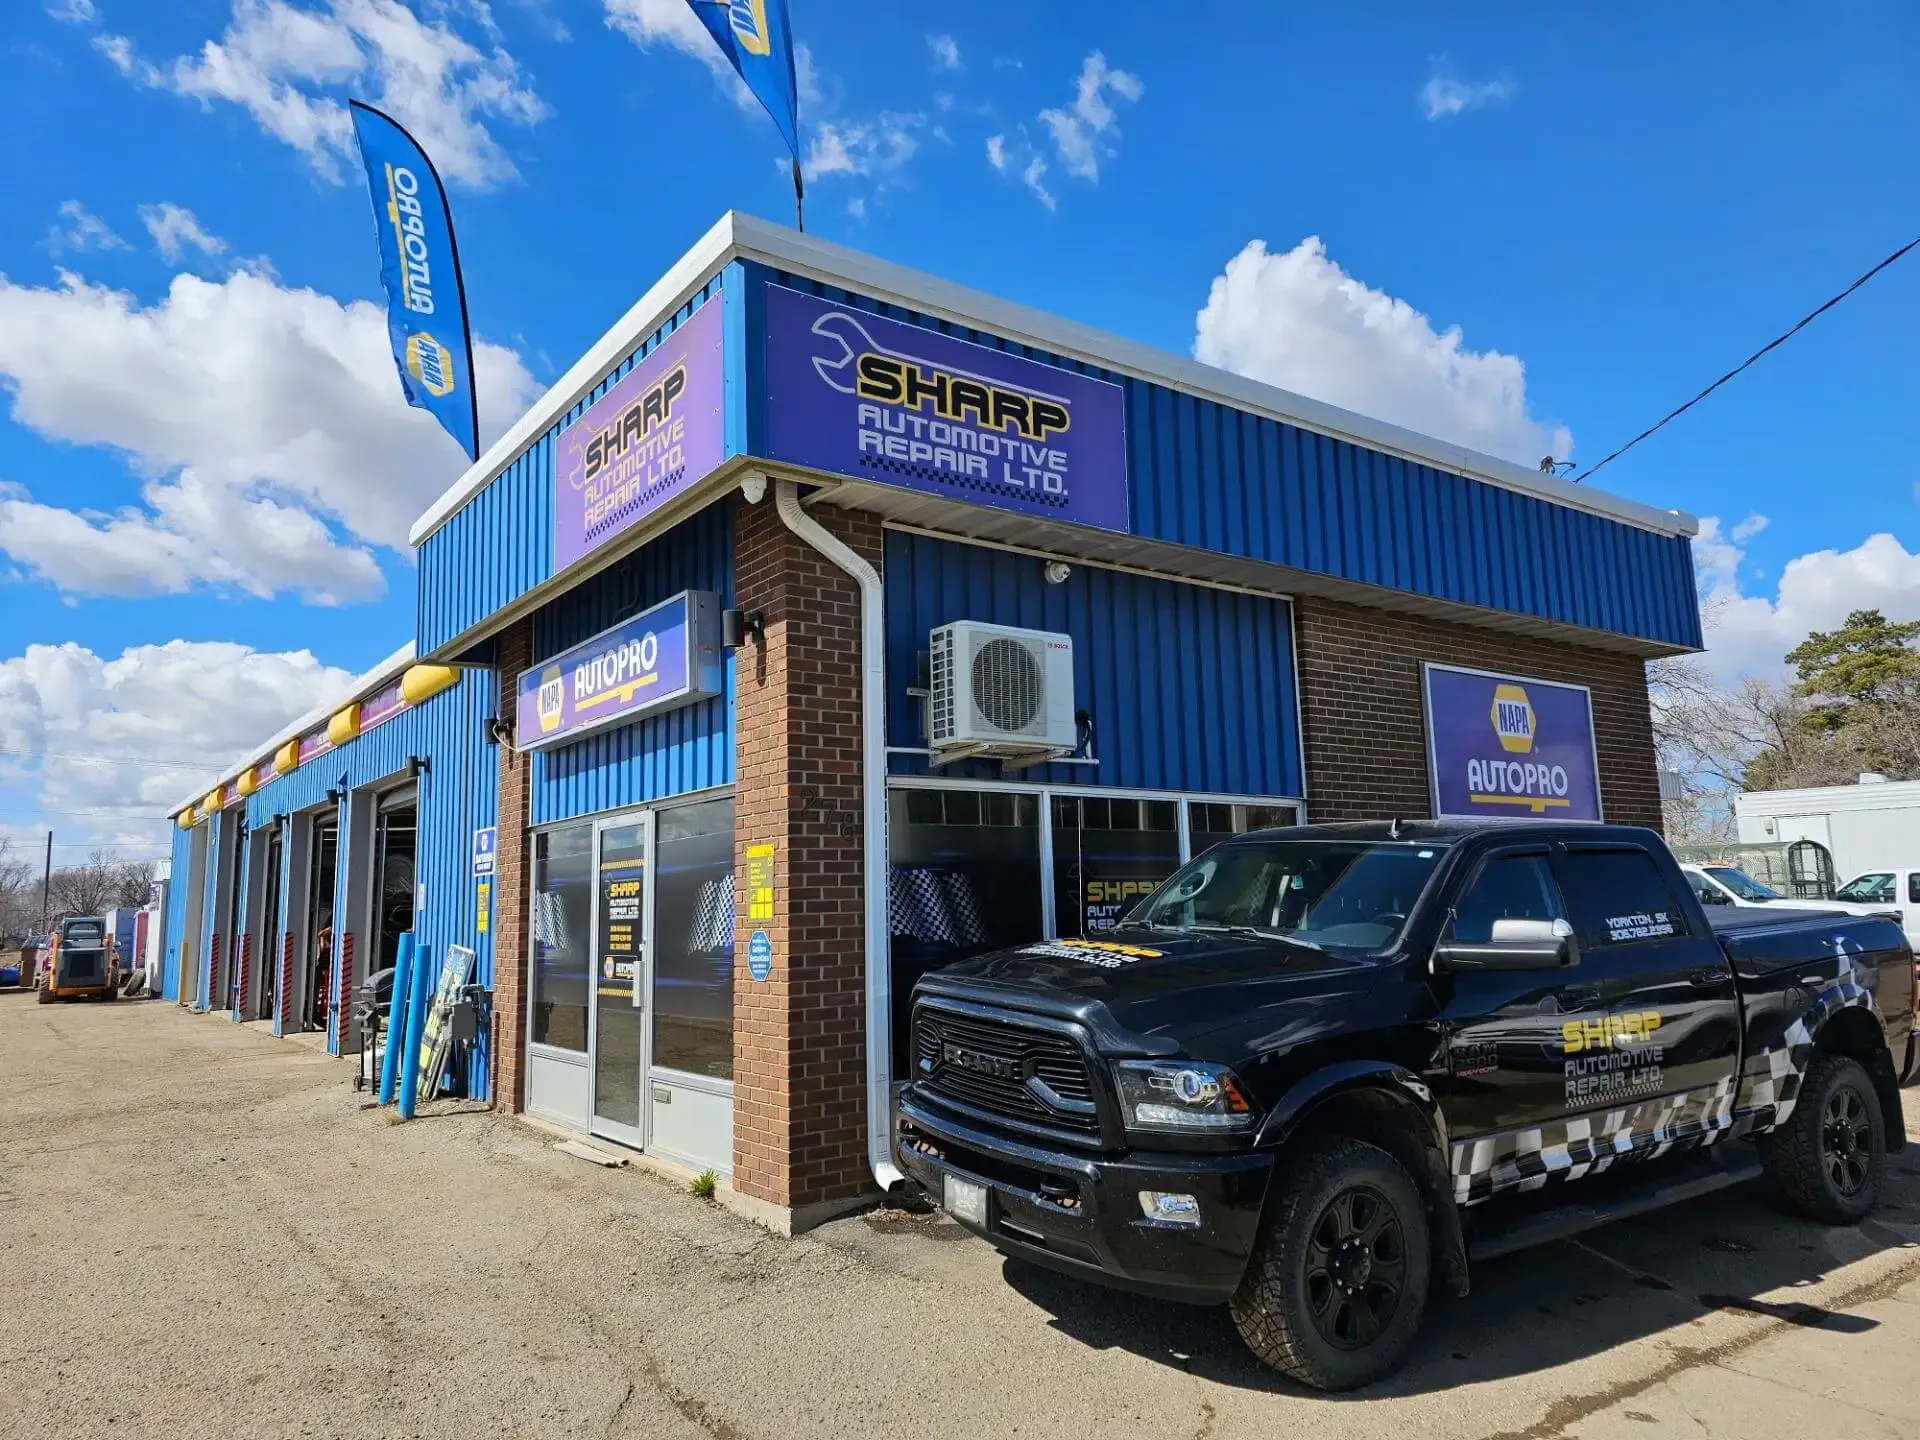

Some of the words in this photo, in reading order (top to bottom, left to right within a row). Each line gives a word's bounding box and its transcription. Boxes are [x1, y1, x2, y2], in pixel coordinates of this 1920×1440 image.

[584, 365, 688, 483] SHARP
[856, 352, 1071, 443] SHARP
[584, 416, 685, 508] AUTOMOTIVE
[857, 403, 1068, 472] AUTOMOTIVE
[858, 429, 989, 479] REPAIR
[1003, 462, 1069, 496] LTD.
[584, 478, 641, 530] REPAIR
[647, 444, 685, 486] LTD.
[574, 632, 658, 700] AUTOPRO
[541, 682, 560, 717] NAPA
[1498, 703, 1530, 735] NAPA
[1467, 758, 1569, 797] AUTOPRO
[610, 881, 640, 898] SHARP
[1562, 1010, 1662, 1053] SHARP
[1564, 1046, 1664, 1078] AUTOMOTIVE
[1565, 1071, 1625, 1098] REPAIR
[1632, 1065, 1664, 1084] LTD.
